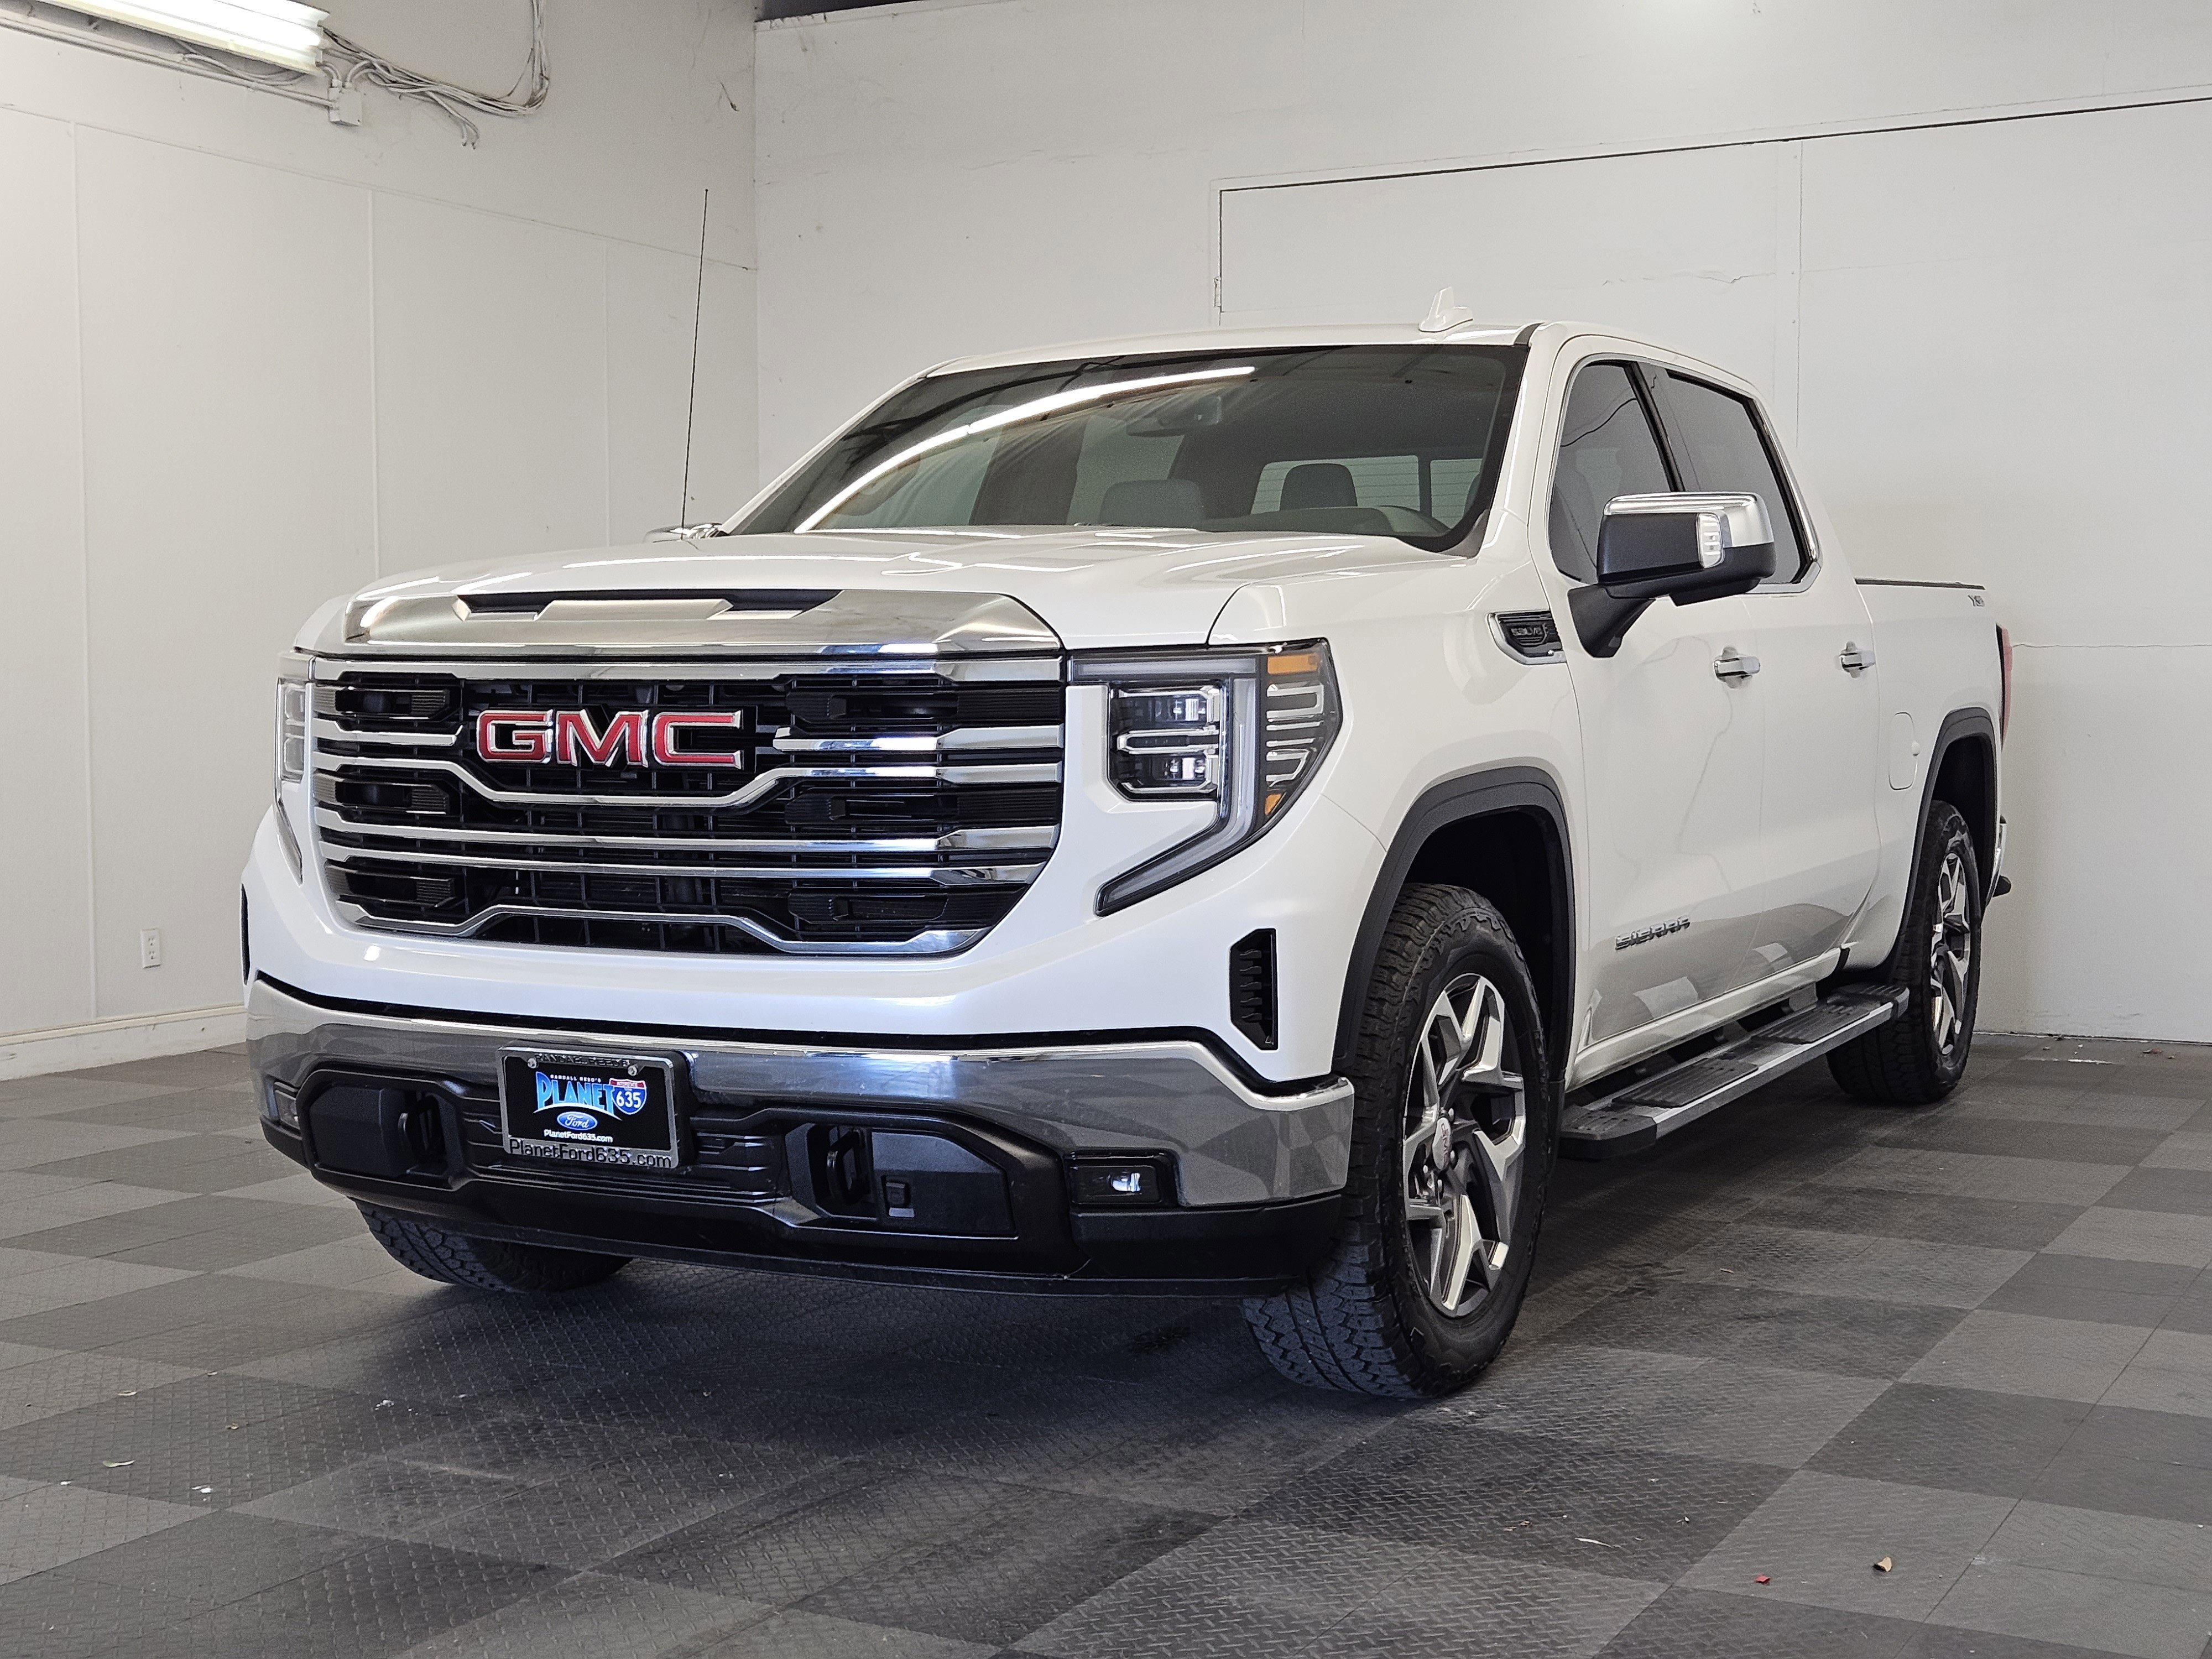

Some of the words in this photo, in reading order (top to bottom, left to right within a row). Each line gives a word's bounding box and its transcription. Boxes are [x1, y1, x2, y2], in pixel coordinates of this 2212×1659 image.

[476, 709, 744, 769] GMC
[1615, 915, 1691, 951] SIERRA
[535, 1071, 614, 1114] PLANET
[617, 1091, 641, 1108] 635
[544, 1129, 613, 1142] PlanetFord635.com
[565, 1114, 589, 1128] Ford
[509, 1139, 671, 1168] PlanetFord635.com
